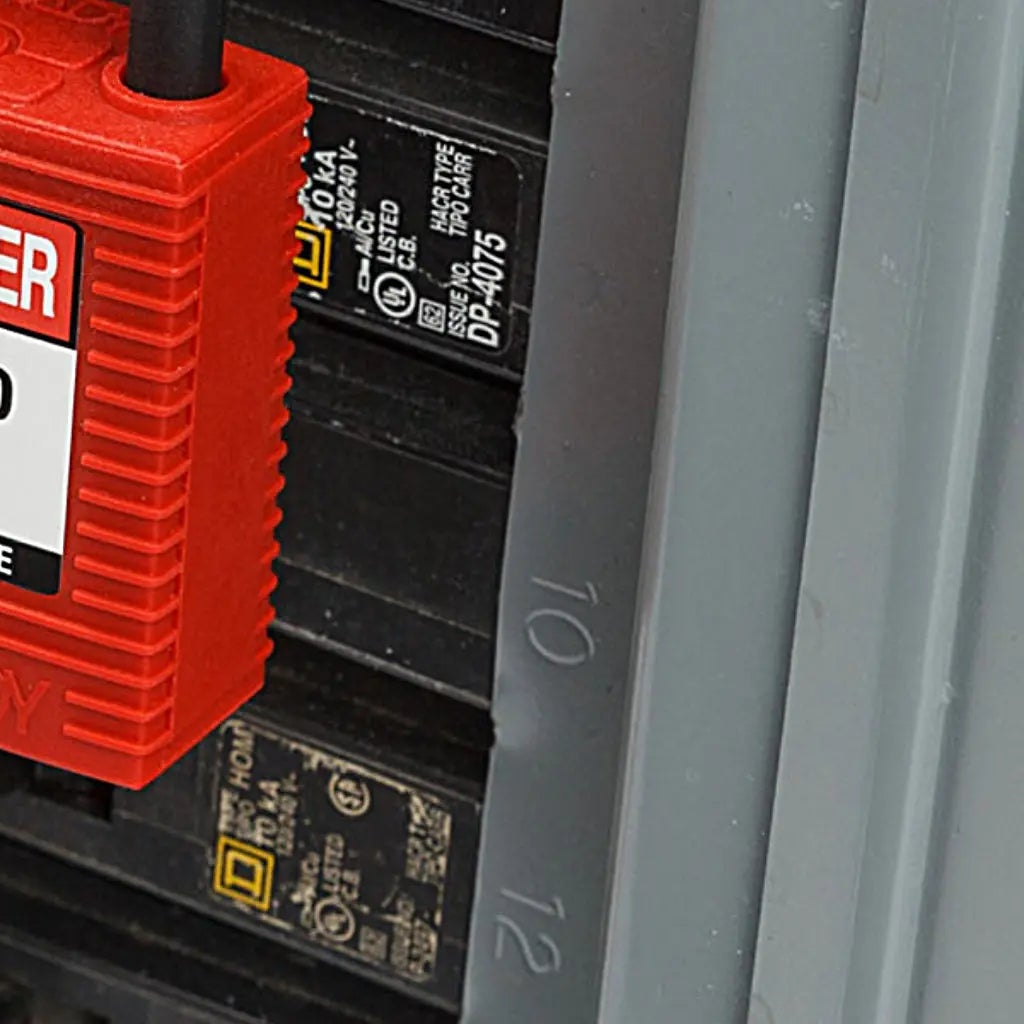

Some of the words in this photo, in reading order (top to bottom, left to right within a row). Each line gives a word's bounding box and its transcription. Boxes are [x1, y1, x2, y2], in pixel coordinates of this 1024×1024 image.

[313, 151, 338, 184] kA
[435, 141, 456, 184] TYPE
[453, 154, 473, 197] CARR
[336, 166, 358, 231] 120/240
[430, 186, 451, 233] HACR
[449, 198, 469, 237] TIPO
[377, 200, 399, 265] LISTED
[397, 235, 418, 271] C.B.
[452, 261, 471, 287] NO.
[467, 229, 507, 348] DP-4075
[448, 290, 468, 338] ISSUE
[524, 575, 599, 666] 10
[495, 886, 566, 974] 12
